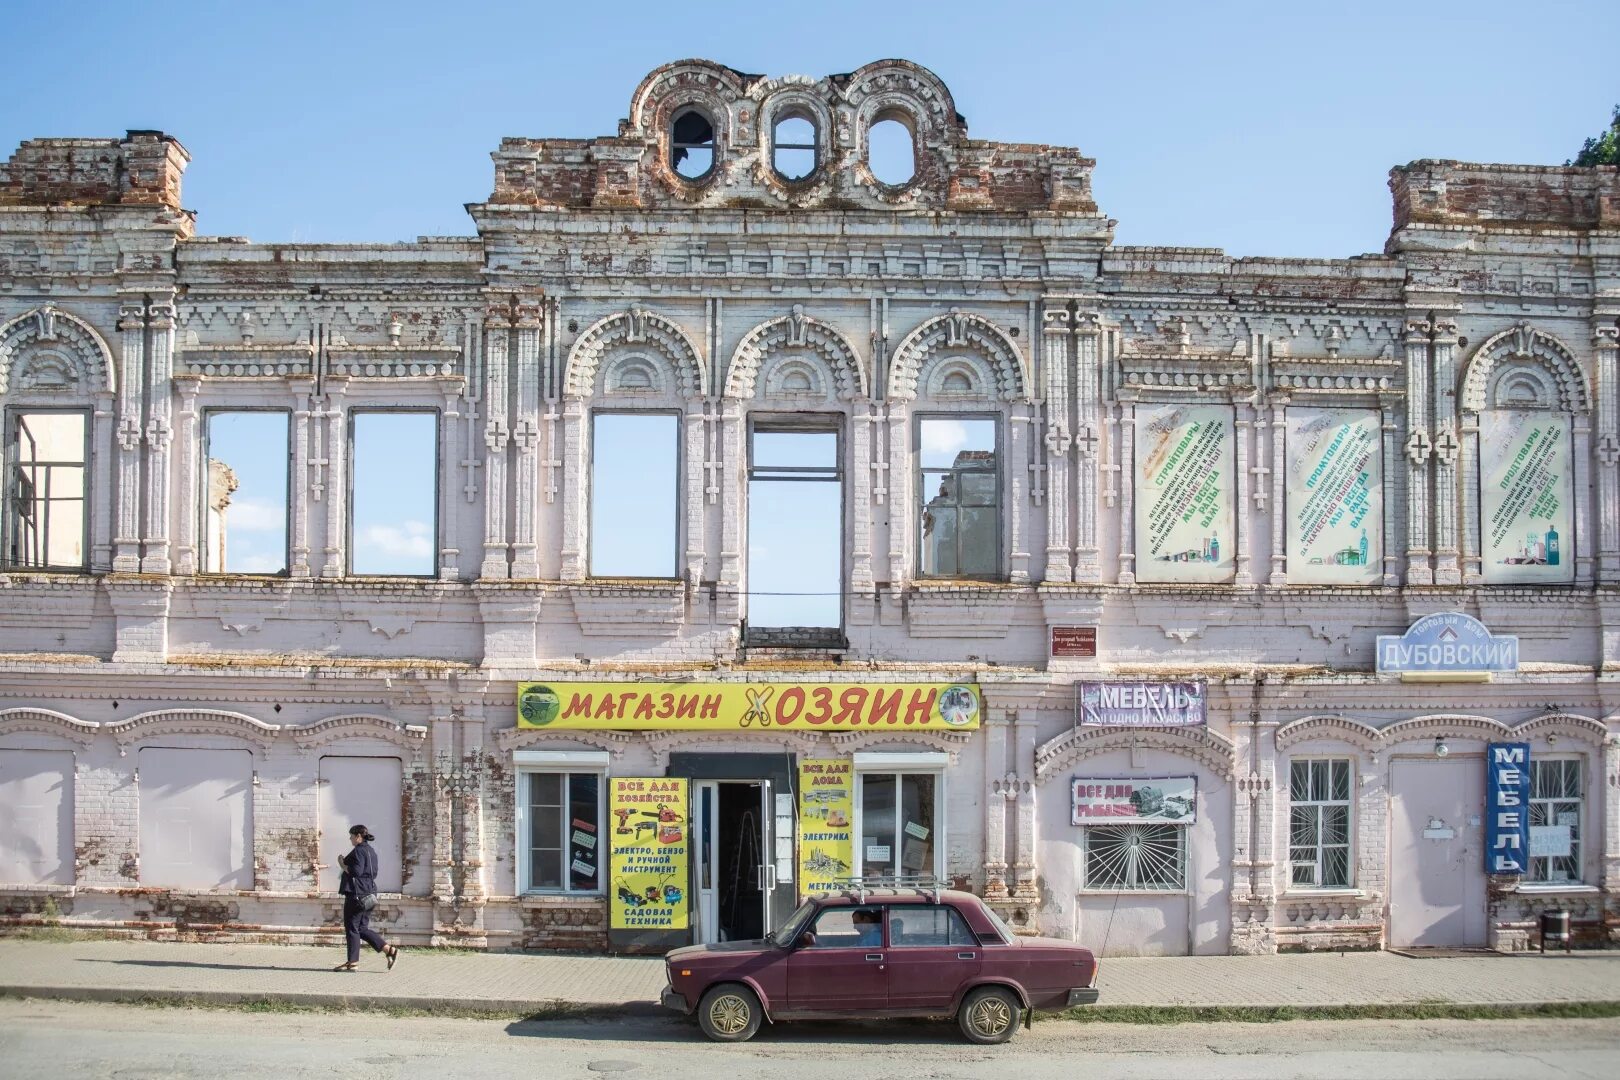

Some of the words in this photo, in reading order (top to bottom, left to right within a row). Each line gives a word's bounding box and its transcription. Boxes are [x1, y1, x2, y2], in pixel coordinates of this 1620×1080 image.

[1155, 421, 1201, 486] СТРОЙТОВАРЫ
[1200, 449, 1222, 479] ЦЕНЫ!
[1307, 424, 1350, 488] ПРОМТОВАРЫ
[1500, 428, 1540, 489] ПРОДТОВАРЫ
[1148, 474, 1180, 519] МЕТАЛЛОПРОКАТ
[1178, 445, 1198, 473] ЧУГУННАЯ
[1298, 465, 1337, 520] ЭЛЕКТРОБЫТОВЫЕ
[1335, 435, 1356, 465] ПРИБОРЫ
[1327, 457, 1359, 503] КЕРАМИЧЕСКАЯ
[1335, 474, 1355, 502] ВЫШЕ
[1356, 451, 1371, 472] ЦЕН!
[1492, 488, 1516, 523] КОЛБАСНЫЕ
[1518, 436, 1548, 481] КОНДИТЕРСКИЕ
[1525, 458, 1543, 484] НАПИТКИ
[1155, 503, 1170, 522] ТРУБЫ
[1169, 479, 1185, 501] МУФТЫ
[1183, 459, 1198, 479] СГОНЫ
[1182, 504, 1196, 523] МЫ
[1194, 470, 1219, 503] ВСЕГДА
[1199, 486, 1220, 514] РАДЫ
[1319, 475, 1339, 502] ГАЗОВЫЕ
[1328, 507, 1344, 527] МЫ
[1343, 471, 1368, 505] ВСЕГДА
[1349, 487, 1369, 513] РАДЫ
[1505, 499, 1525, 528] КОНФЕТЫ
[1537, 466, 1546, 479] НАС
[1545, 450, 1556, 466] ЕСТЬ
[1528, 503, 1540, 519] МЫ
[1538, 474, 1559, 504] ВСЕГДА
[1156, 512, 1172, 533] ШИФЕР
[1171, 489, 1187, 512] ЦЕМЕНТ
[1201, 503, 1220, 528] ВАМ!
[1538, 494, 1555, 517] РАДЫ
[1545, 500, 1560, 520] ВАМ!
[1464, 620, 1485, 639] ДОМ
[1383, 641, 1512, 668] ДУБОВСКИЙ
[561, 692, 722, 719] МАГАЗИН
[739, 686, 937, 727] ХОЗЯИН
[1100, 687, 1189, 709] МЕБЕЛЬ
[1143, 712, 1150, 723] И
[803, 765, 823, 773] ВСЕ
[826, 765, 848, 774] ДЛЯ
[812, 776, 843, 785] ДОМА
[618, 782, 644, 791] ВСЕ
[649, 782, 679, 792] ДЛЯ
[618, 793, 680, 803] ХОЗЯЙСТВА
[1078, 785, 1101, 798] ВСЕ
[1105, 785, 1133, 799] ДЛЯ
[1494, 748, 1523, 870] МЕБЕЛЬ
[803, 833, 849, 841] ЭЛЕКТРИКА
[614, 847, 654, 855] ЭЛЕКТРО,
[637, 855, 671, 864] РУЧНОЙ
[624, 908, 673, 916] САДОВАЯ
